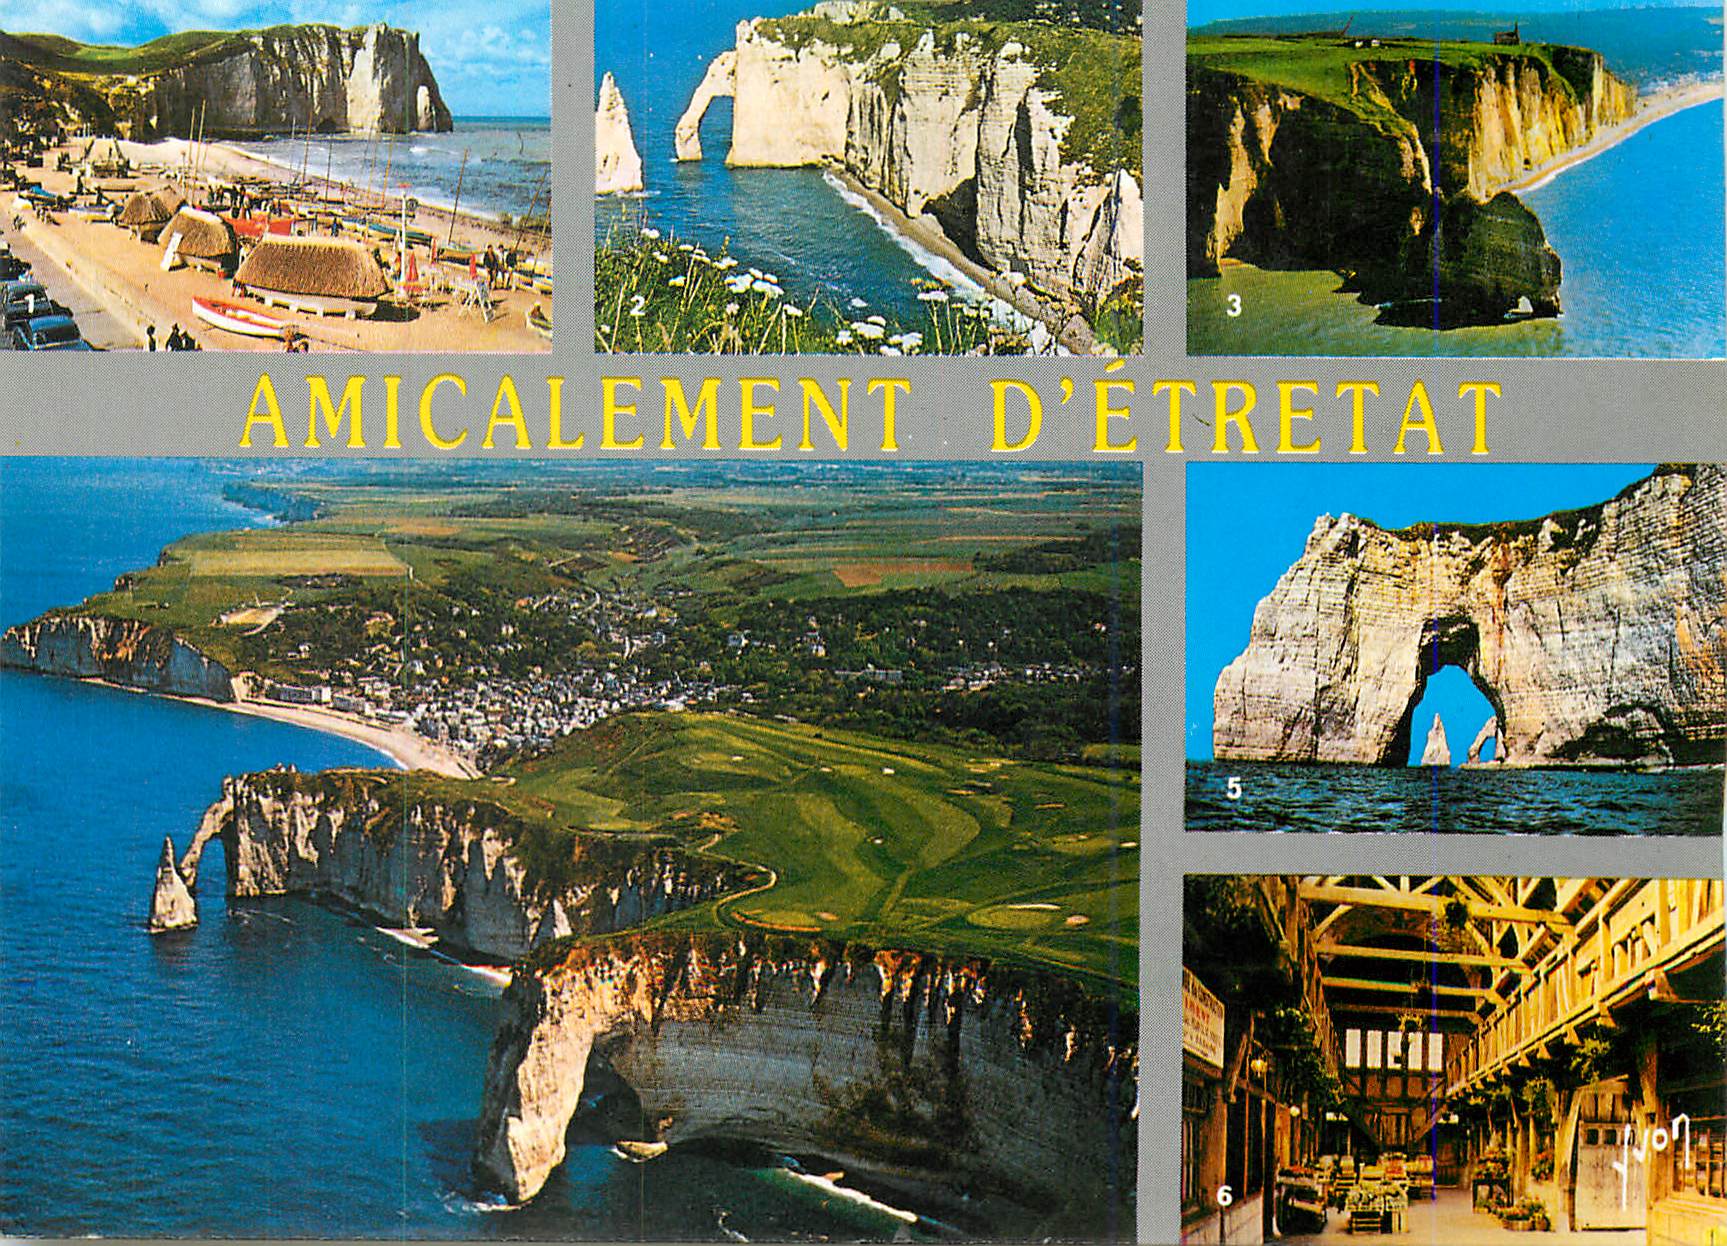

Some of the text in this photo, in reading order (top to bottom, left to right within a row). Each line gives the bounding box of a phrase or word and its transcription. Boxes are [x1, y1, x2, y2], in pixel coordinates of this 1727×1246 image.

[24, 294, 34, 314] 1
[630, 295, 646, 317] 2
[1227, 293, 1242, 317] 3
[239, 373, 912, 451] AMICALEMENT
[1227, 777, 1242, 799] 5
[1217, 1185, 1233, 1207] 6
